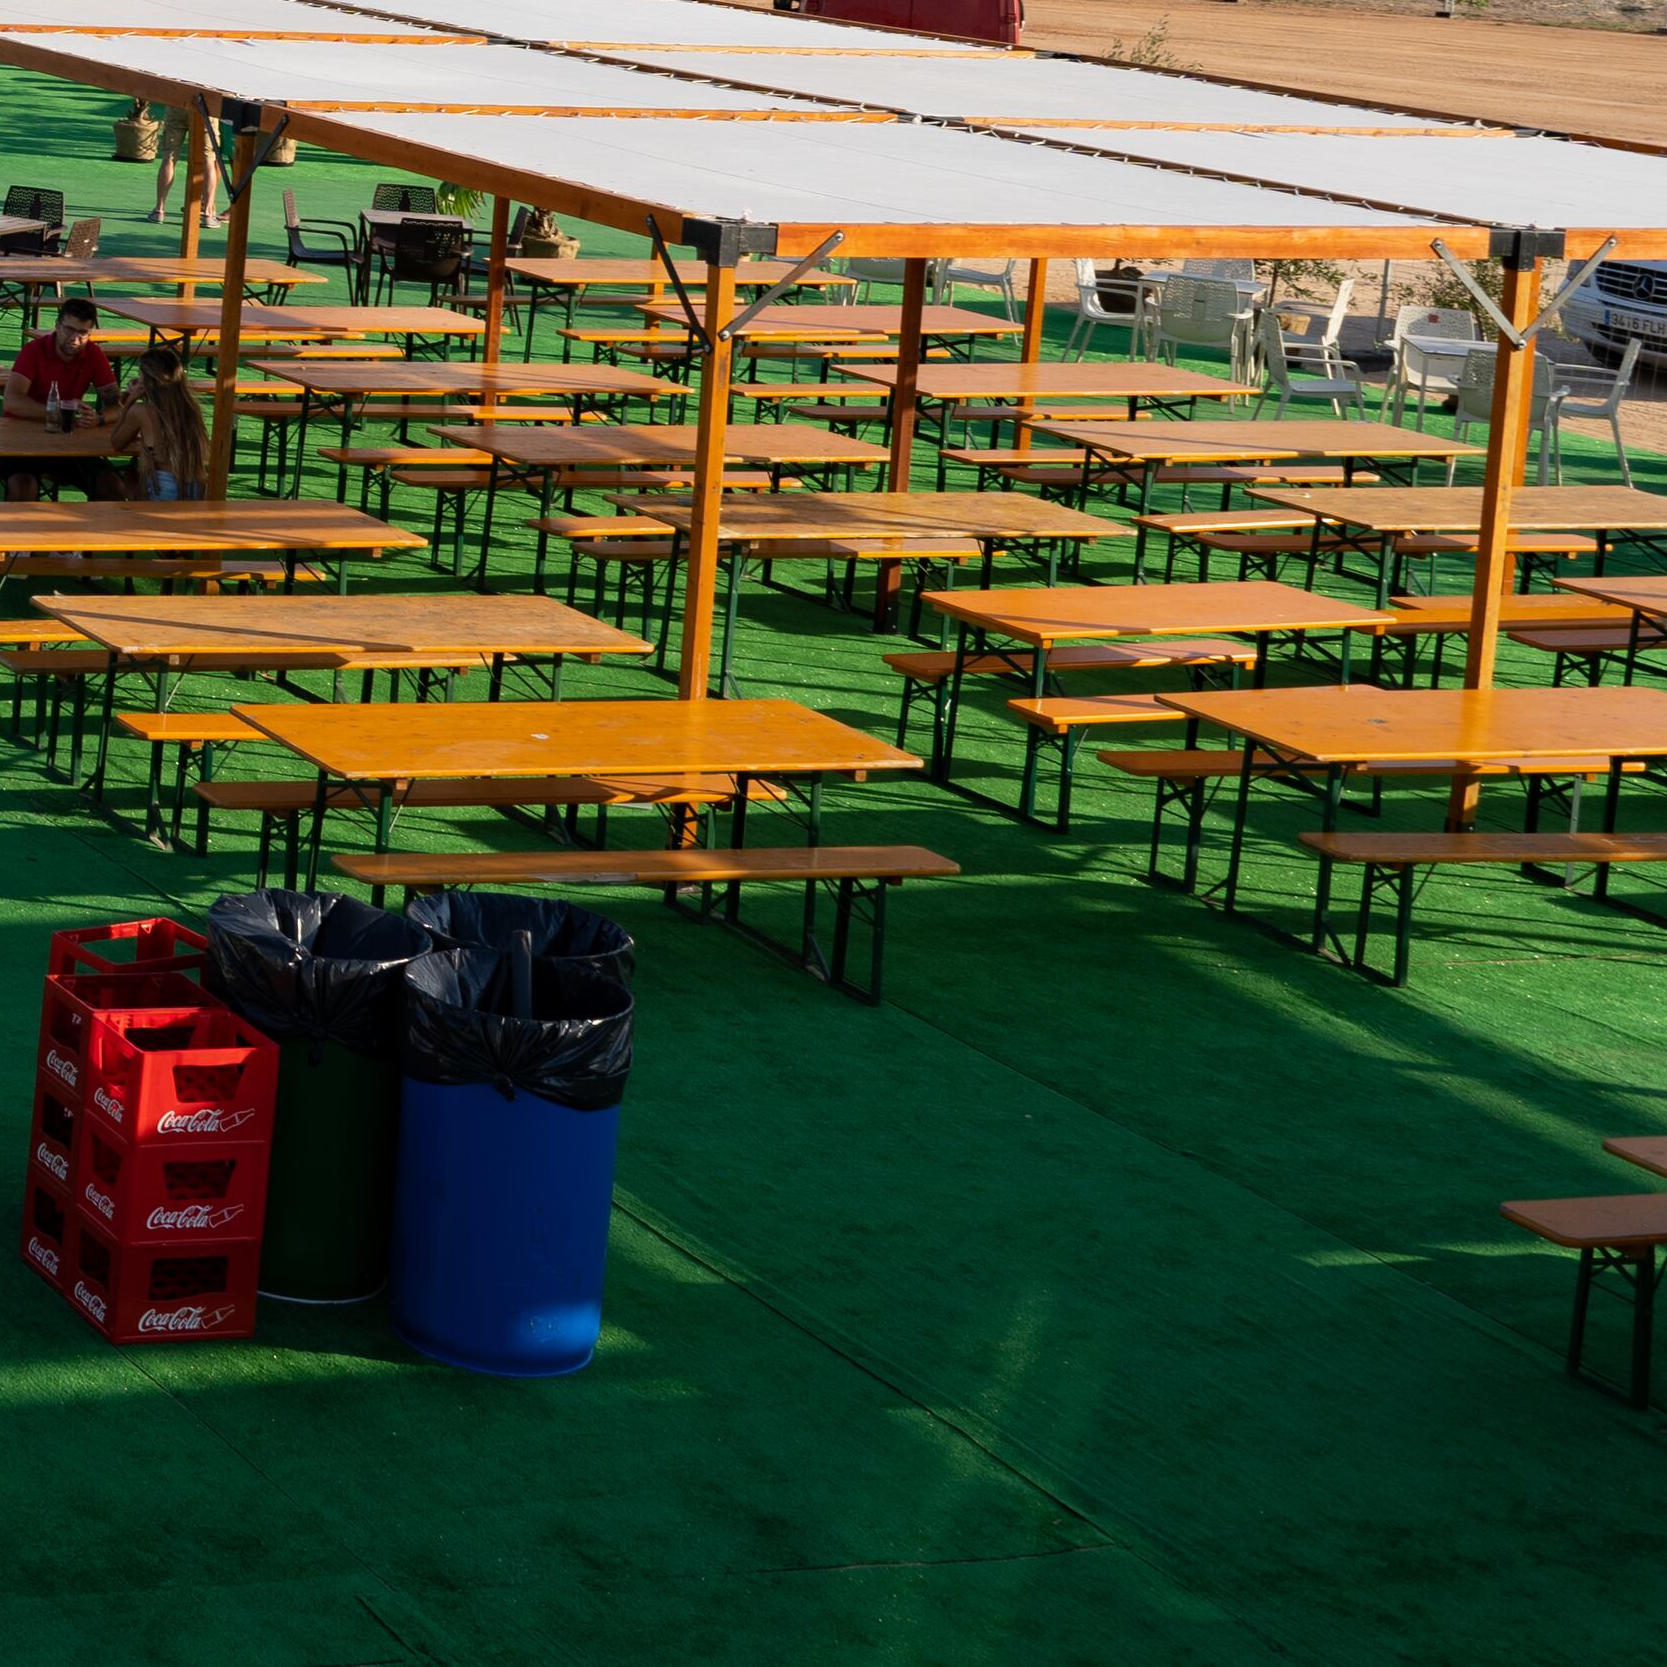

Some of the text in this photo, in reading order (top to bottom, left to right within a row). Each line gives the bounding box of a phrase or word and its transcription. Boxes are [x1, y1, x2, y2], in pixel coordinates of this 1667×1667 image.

[47, 1050, 78, 1087] Coca-Cola
[94, 1087, 124, 1124] Coca-Cola
[157, 1109, 224, 1134] Coca-Cola
[38, 1143, 69, 1182] Coca-Cola
[86, 1183, 116, 1221] Coca-Cola
[146, 1205, 213, 1230] Coca-Cola
[28, 1237, 60, 1277] Coca-Cola
[74, 1281, 107, 1323] Coca-Cola
[138, 1306, 206, 1332] Coca-Cola
